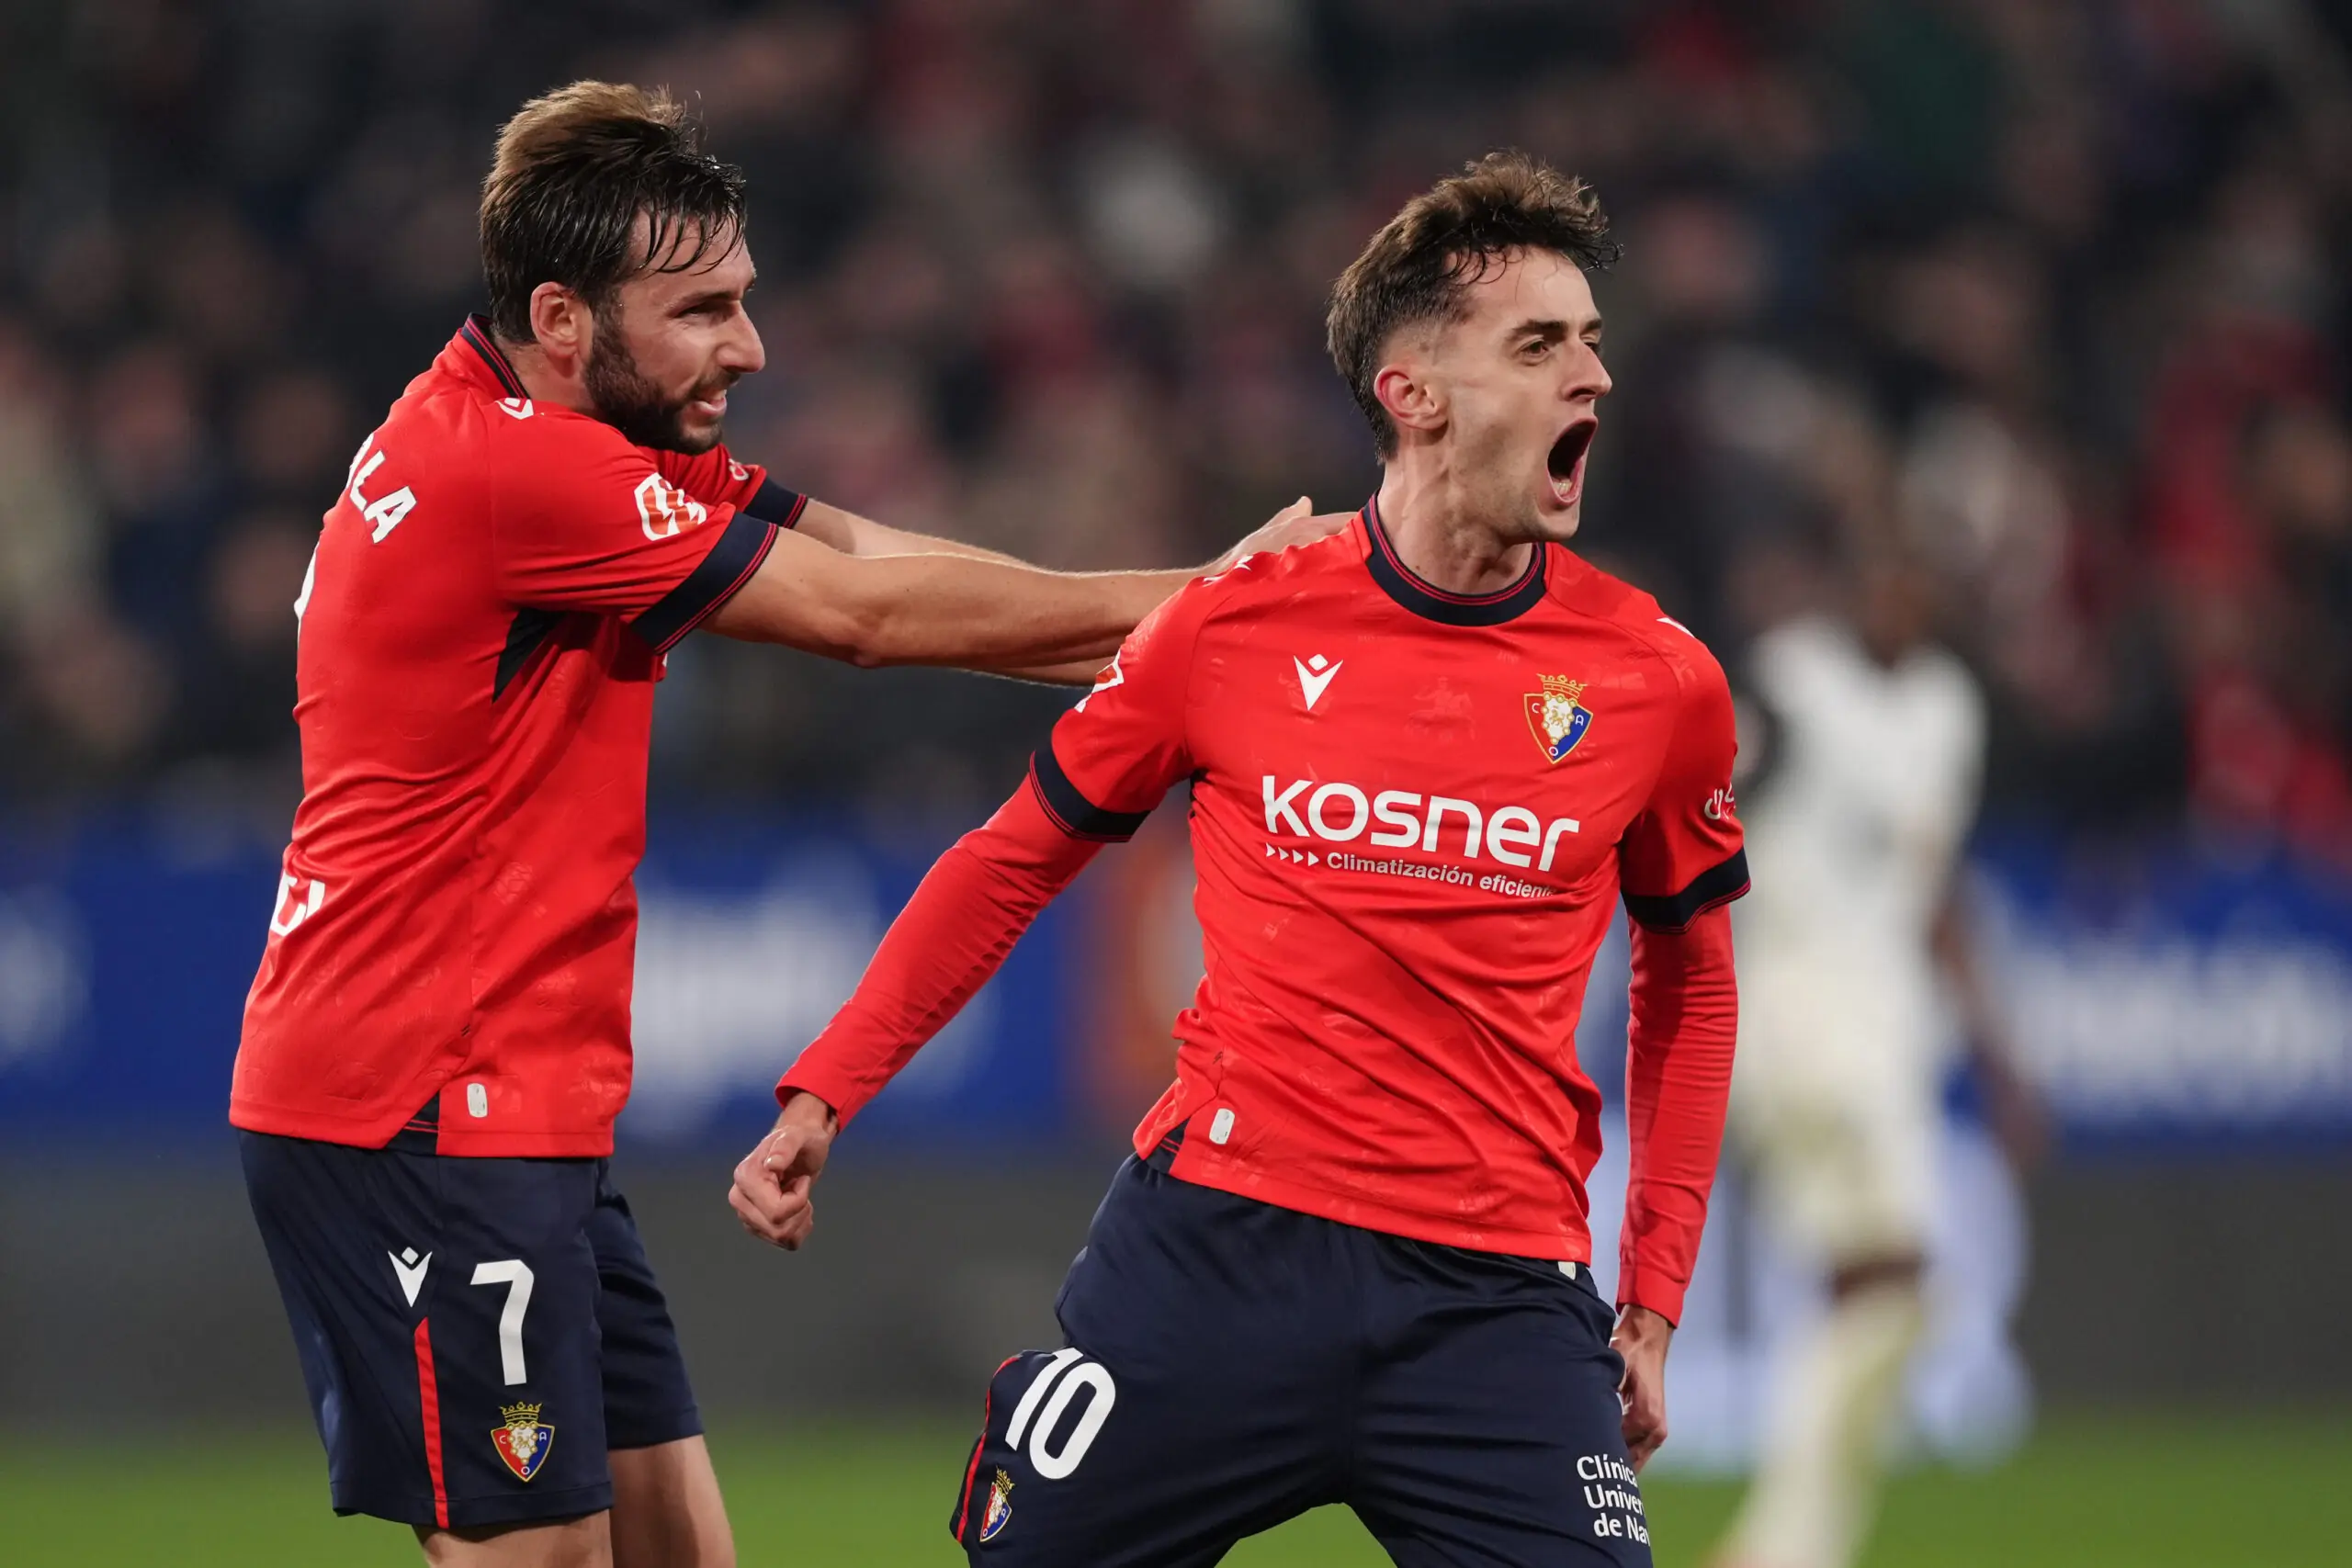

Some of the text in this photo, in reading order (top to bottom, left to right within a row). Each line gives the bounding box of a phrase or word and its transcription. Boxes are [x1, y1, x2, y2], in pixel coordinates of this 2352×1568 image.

[1327, 852, 1474, 886] Climatización
[470, 1259, 534, 1386] 7
[1005, 1348, 1115, 1480] 10
[1584, 1483, 1646, 1517] Univer
[1593, 1512, 1623, 1537] de
